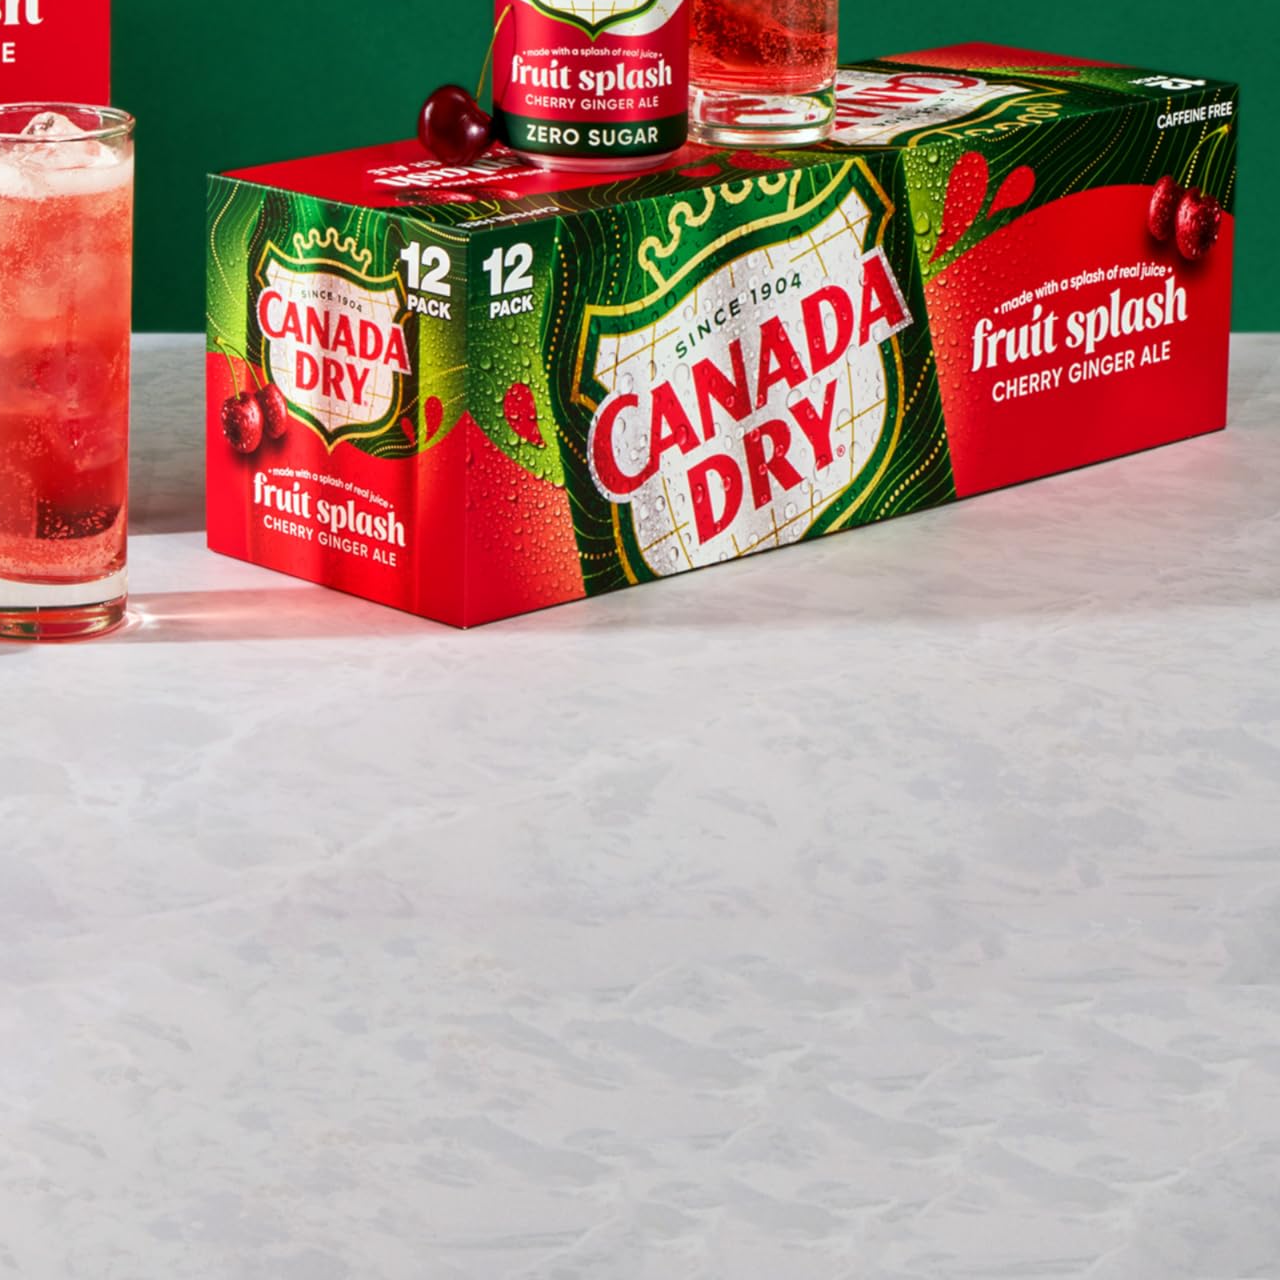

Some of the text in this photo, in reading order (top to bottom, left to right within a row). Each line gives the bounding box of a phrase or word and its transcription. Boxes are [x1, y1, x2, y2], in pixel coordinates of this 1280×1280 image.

[511, 54, 673, 96] fruit splash
[527, 48, 550, 57] made
[551, 47, 571, 56] with
[580, 46, 610, 57] splash
[612, 48, 622, 56] of
[622, 48, 639, 57] real
[639, 49, 658, 59] juice
[525, 94, 660, 111] CHERRY GINGER ALE
[1157, 101, 1233, 129] CAFFEINE FREE
[526, 124, 659, 147] ZERO SUGAR
[400, 240, 452, 297] 12
[482, 242, 534, 297] 12
[1000, 261, 1166, 315] made with a splash of real juice
[301, 289, 363, 313] SINCE 1904
[407, 295, 452, 320] PACK
[490, 295, 534, 320] PACK
[675, 272, 803, 360] SINCE 1904
[971, 275, 1189, 373] fruit splash
[259, 290, 411, 372] CANADA
[592, 254, 907, 495] CANADA
[992, 340, 1171, 403] CHERRY GINGER ALE
[253, 471, 407, 548] fruit splash
[273, 466, 389, 508] made with a splash of real juice
[263, 514, 397, 567] CHERRY GINGER ALE
